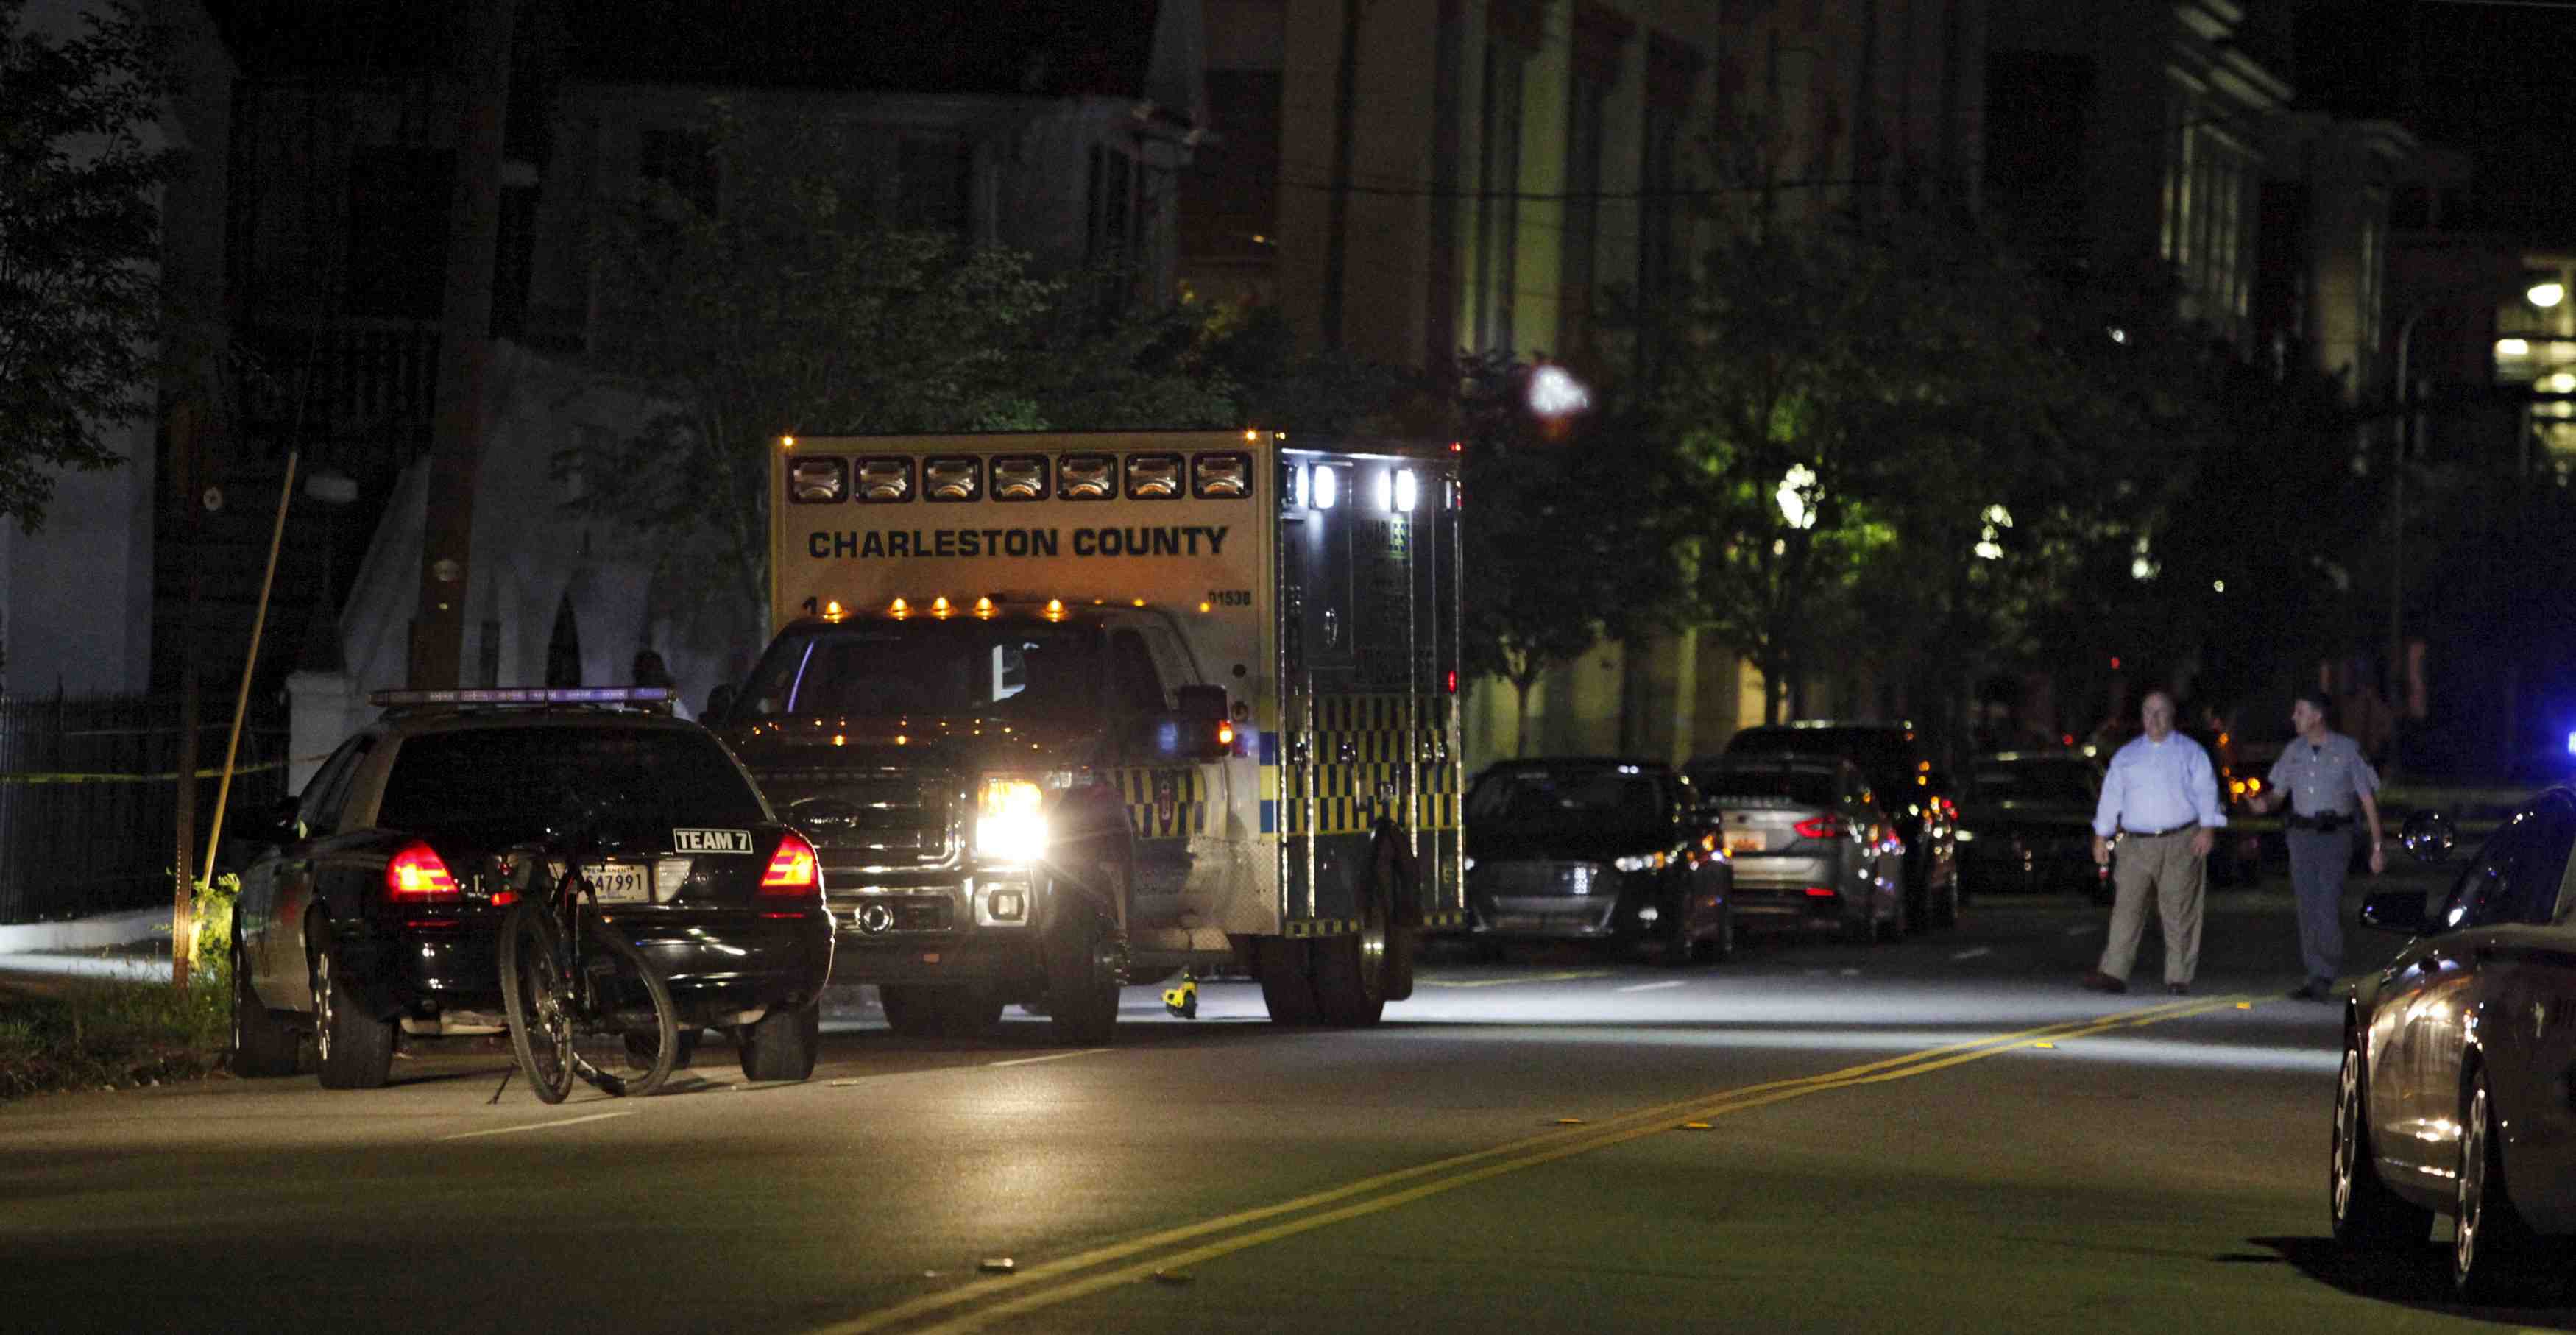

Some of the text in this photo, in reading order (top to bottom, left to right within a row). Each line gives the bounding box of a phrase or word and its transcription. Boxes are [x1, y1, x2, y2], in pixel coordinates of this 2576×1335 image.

[809, 527, 1228, 558] CHARLESTON COUNTY
[677, 832, 747, 849] TEAM 7
